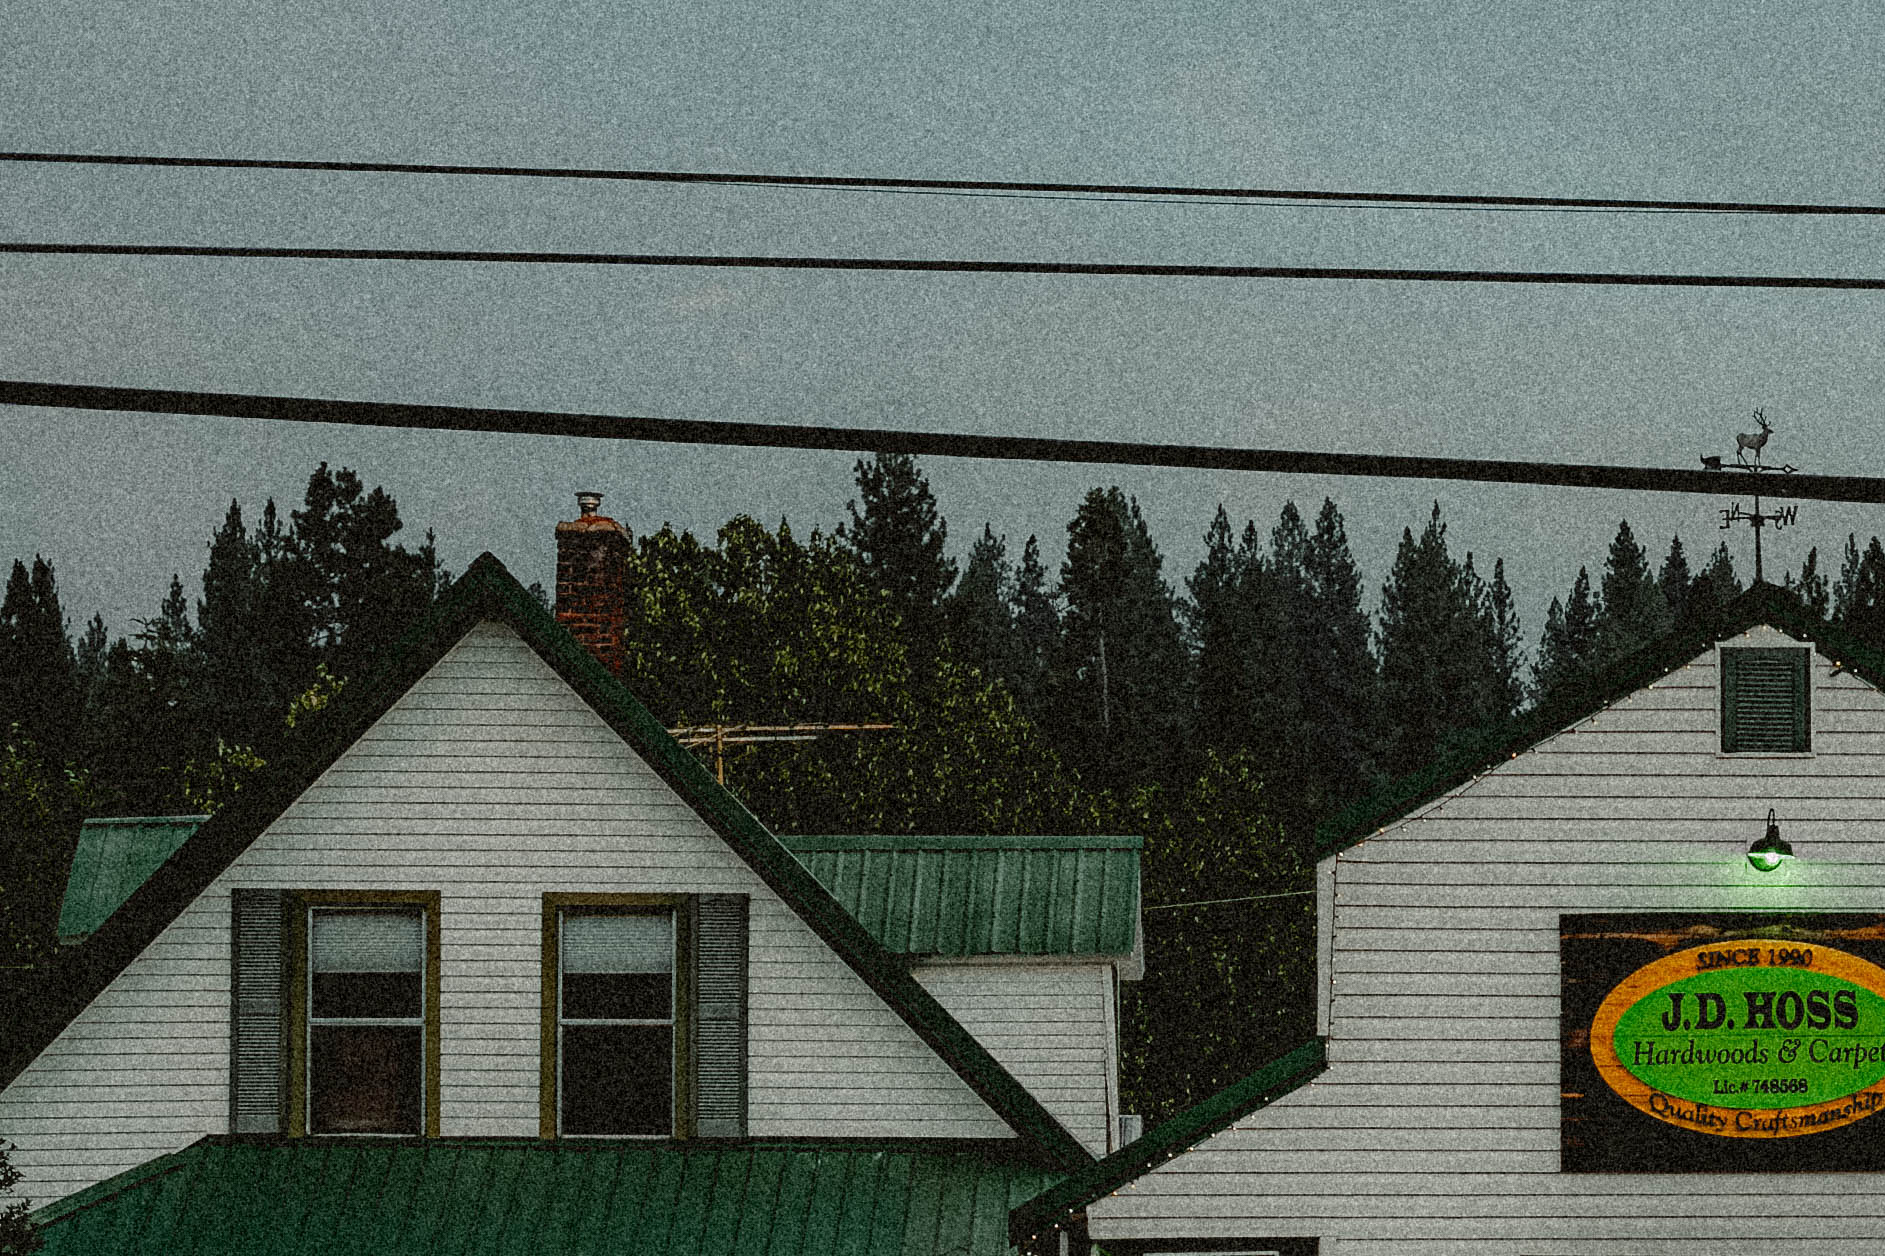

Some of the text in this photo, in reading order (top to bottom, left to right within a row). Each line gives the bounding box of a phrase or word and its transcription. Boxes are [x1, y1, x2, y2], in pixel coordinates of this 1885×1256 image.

[1696, 948, 1814, 970] SINCE 1990
[1661, 990, 1859, 1031] J.D. HOSS
[1633, 1039, 1768, 1066] Hardwoods
[1778, 1038, 1801, 1063] &
[1649, 1092, 1884, 1135] Quality Craftsmanship
